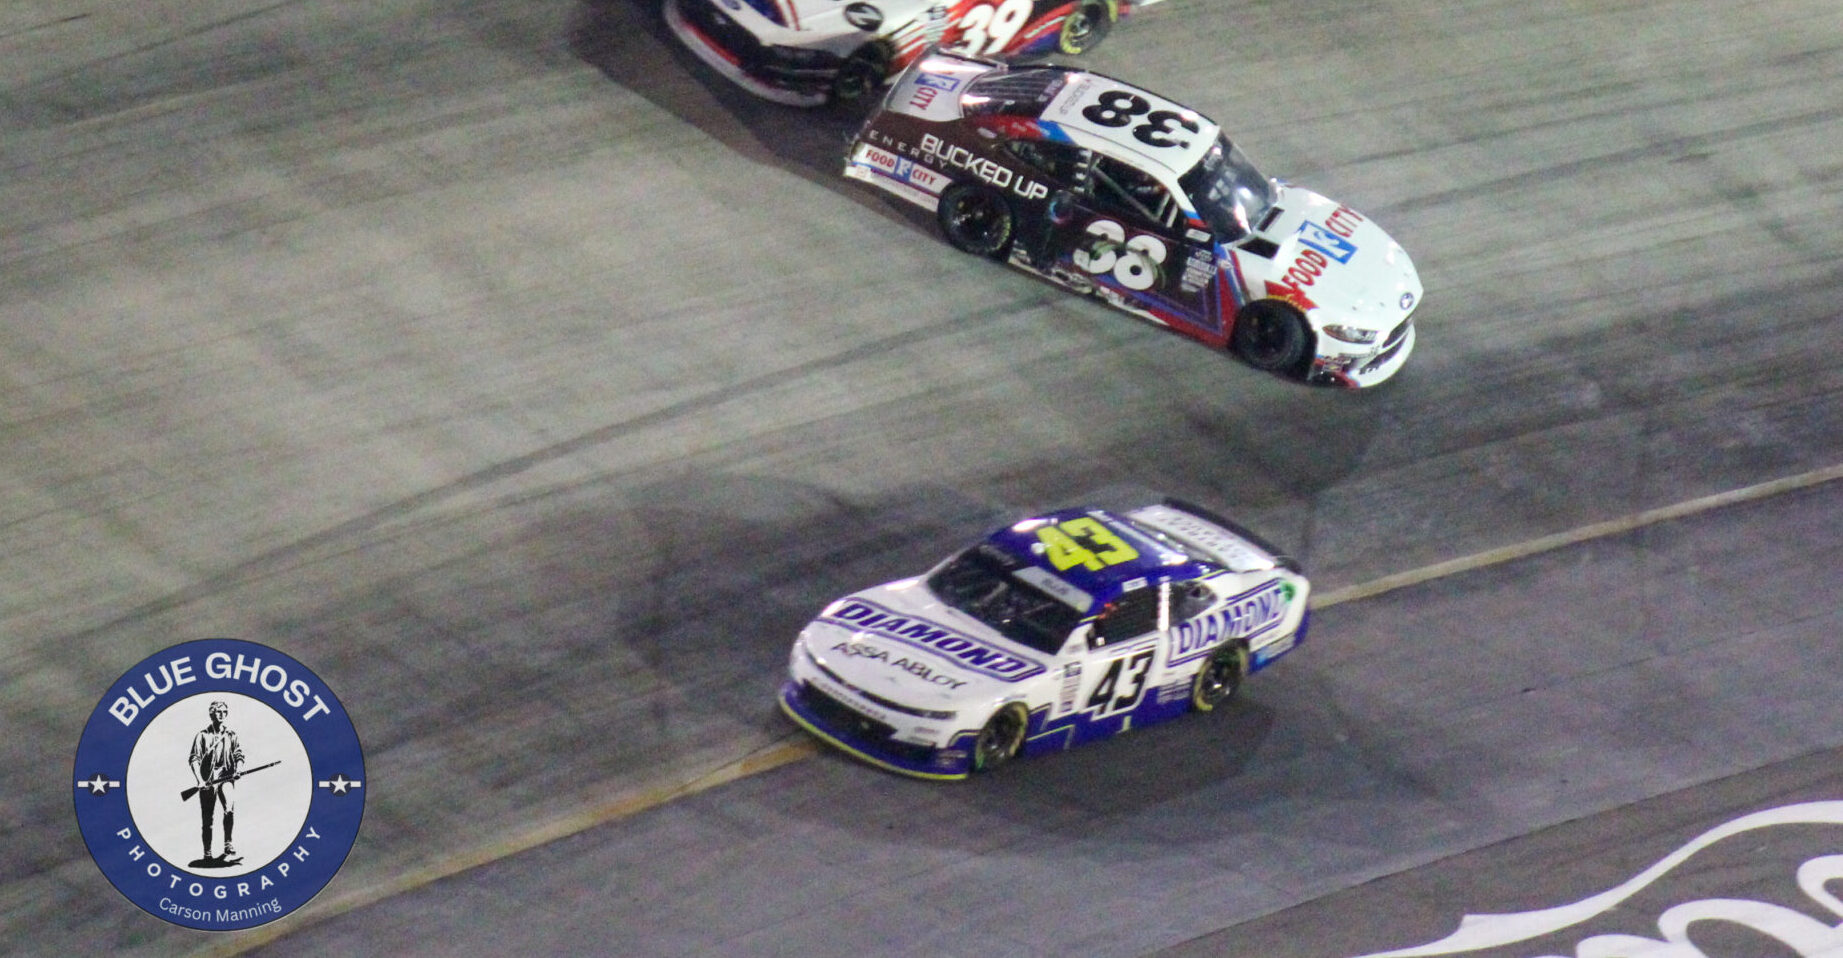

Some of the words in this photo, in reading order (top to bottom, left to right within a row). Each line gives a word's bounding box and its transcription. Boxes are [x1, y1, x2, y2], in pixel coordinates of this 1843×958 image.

[957, 0, 1034, 55] 39
[867, 130, 950, 170] ENERGY
[1082, 89, 1200, 150] 38
[865, 148, 897, 172] FOOD
[911, 167, 937, 187] CITY
[920, 133, 1013, 188] BUCKED
[1012, 174, 1049, 202] UP
[1072, 218, 1168, 291] 38
[1281, 248, 1328, 294] FOOD
[1324, 204, 1364, 239] CITY
[1036, 516, 1140, 572] 43
[831, 641, 891, 664] ASSA
[891, 657, 968, 691] ABLOY
[832, 601, 1029, 676] DIAMOND
[1087, 649, 1156, 716] 43
